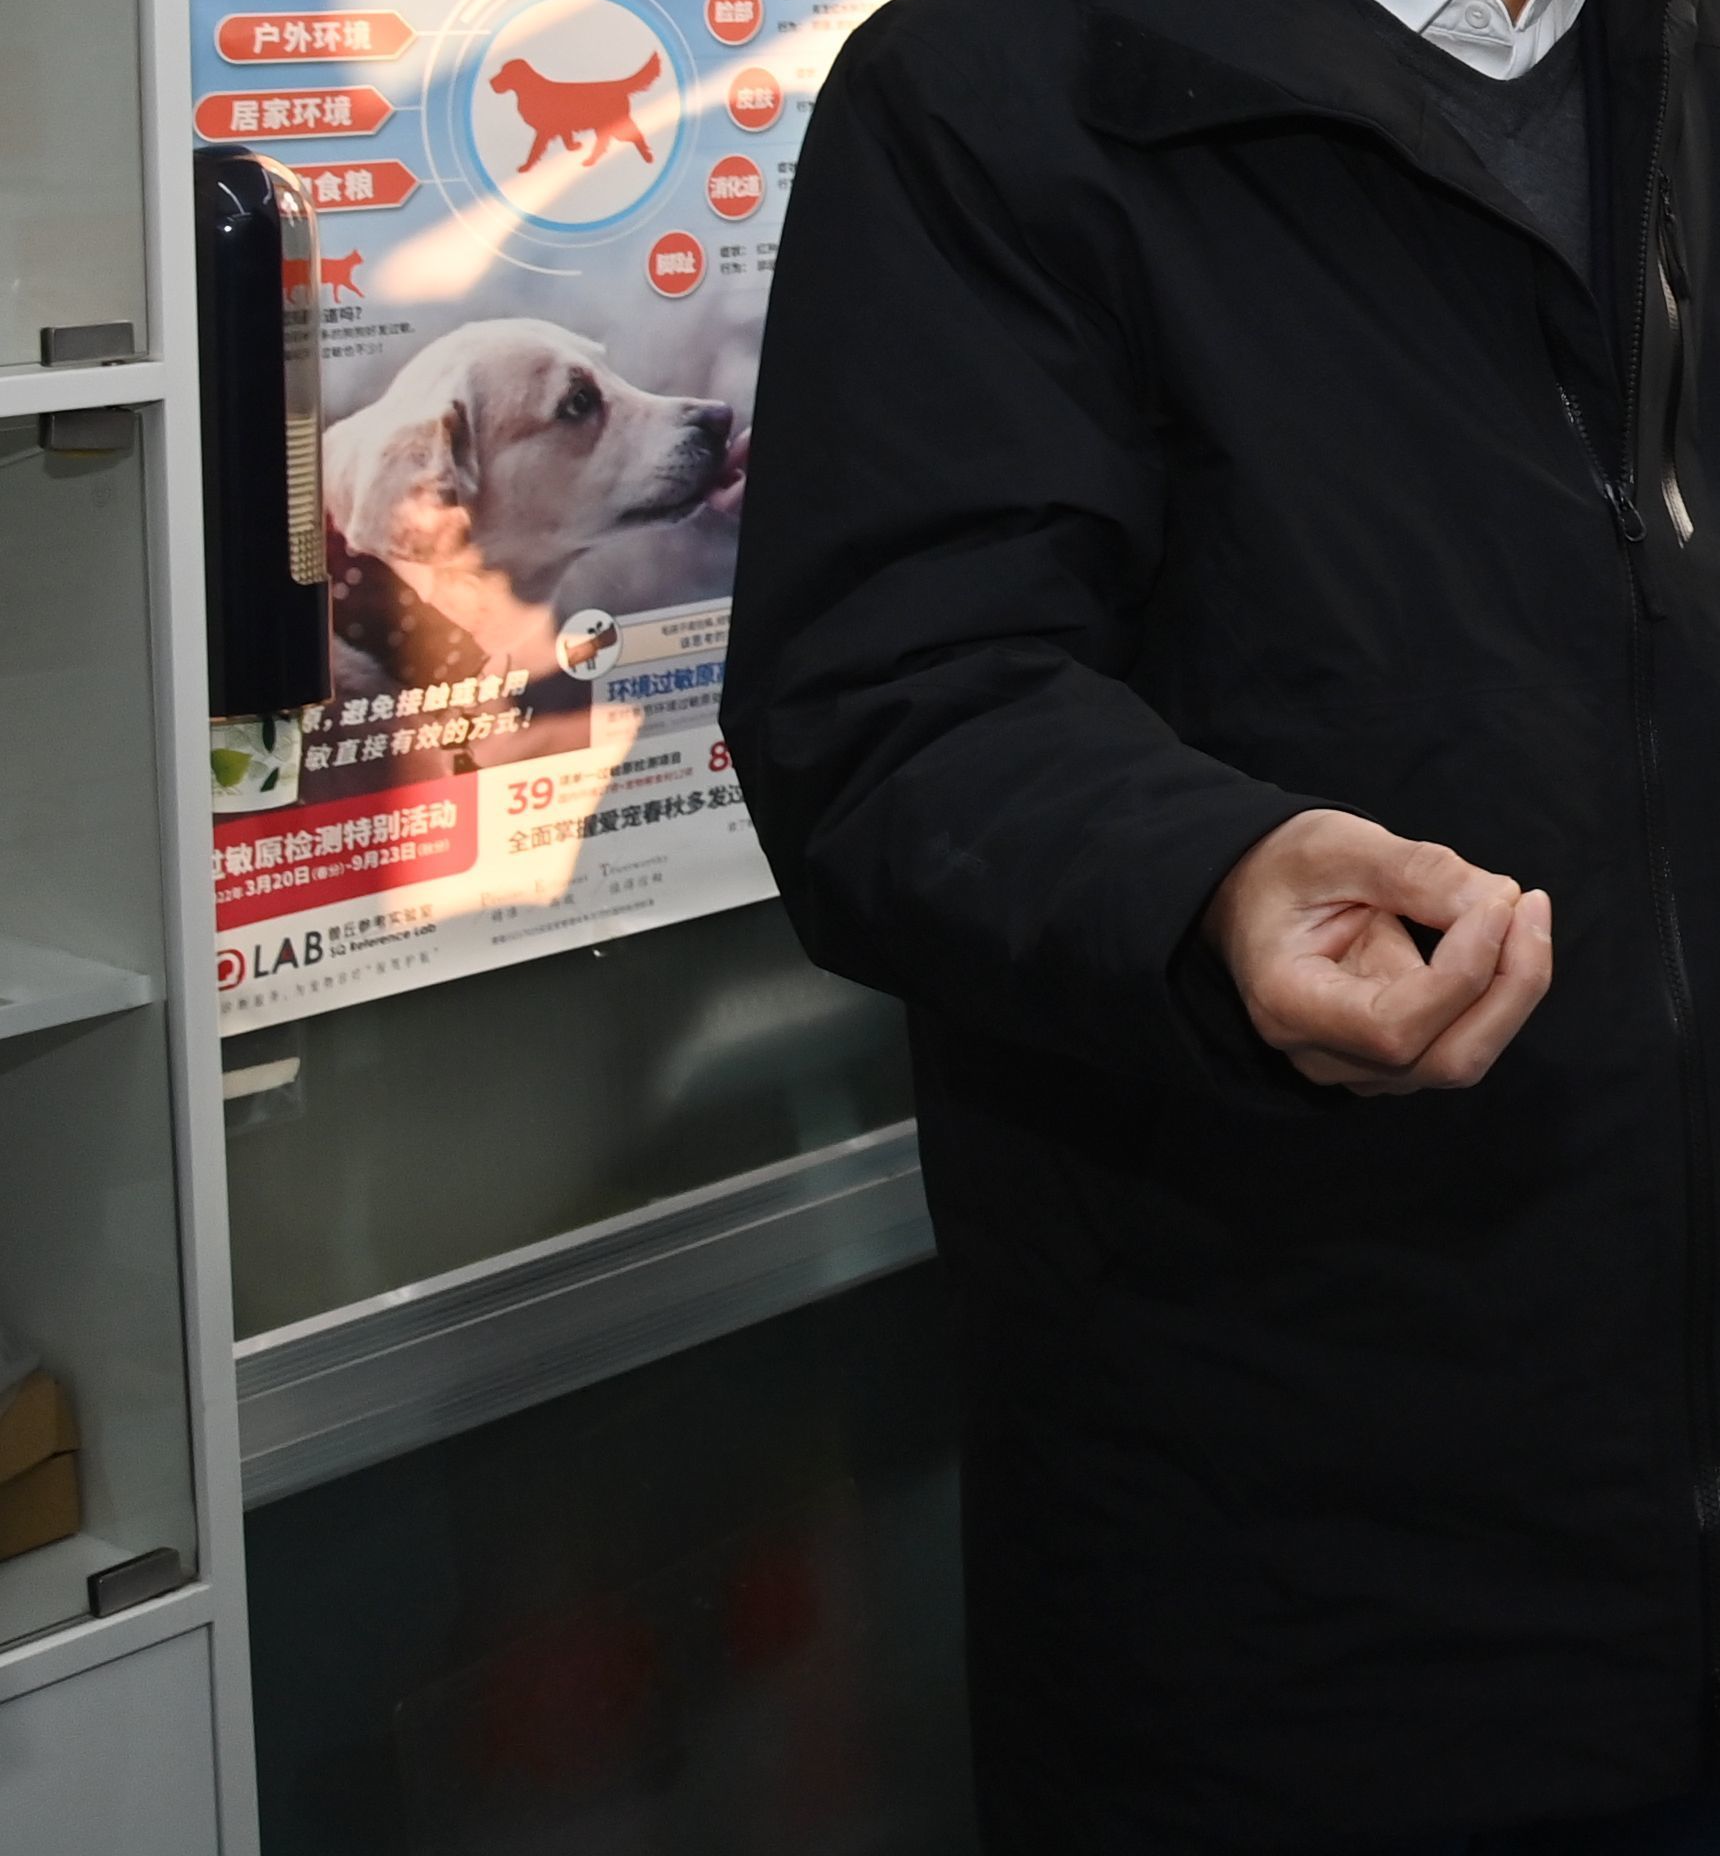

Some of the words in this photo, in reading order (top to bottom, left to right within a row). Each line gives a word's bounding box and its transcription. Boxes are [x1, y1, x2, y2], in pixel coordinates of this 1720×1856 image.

[714, 0, 754, 23] 脸部
[253, 21, 372, 54] 户外环境
[230, 96, 353, 132] 居家环境
[710, 175, 762, 199] 消化道
[708, 741, 734, 772] 8
[507, 777, 555, 815] 39
[253, 931, 323, 979] LAB
